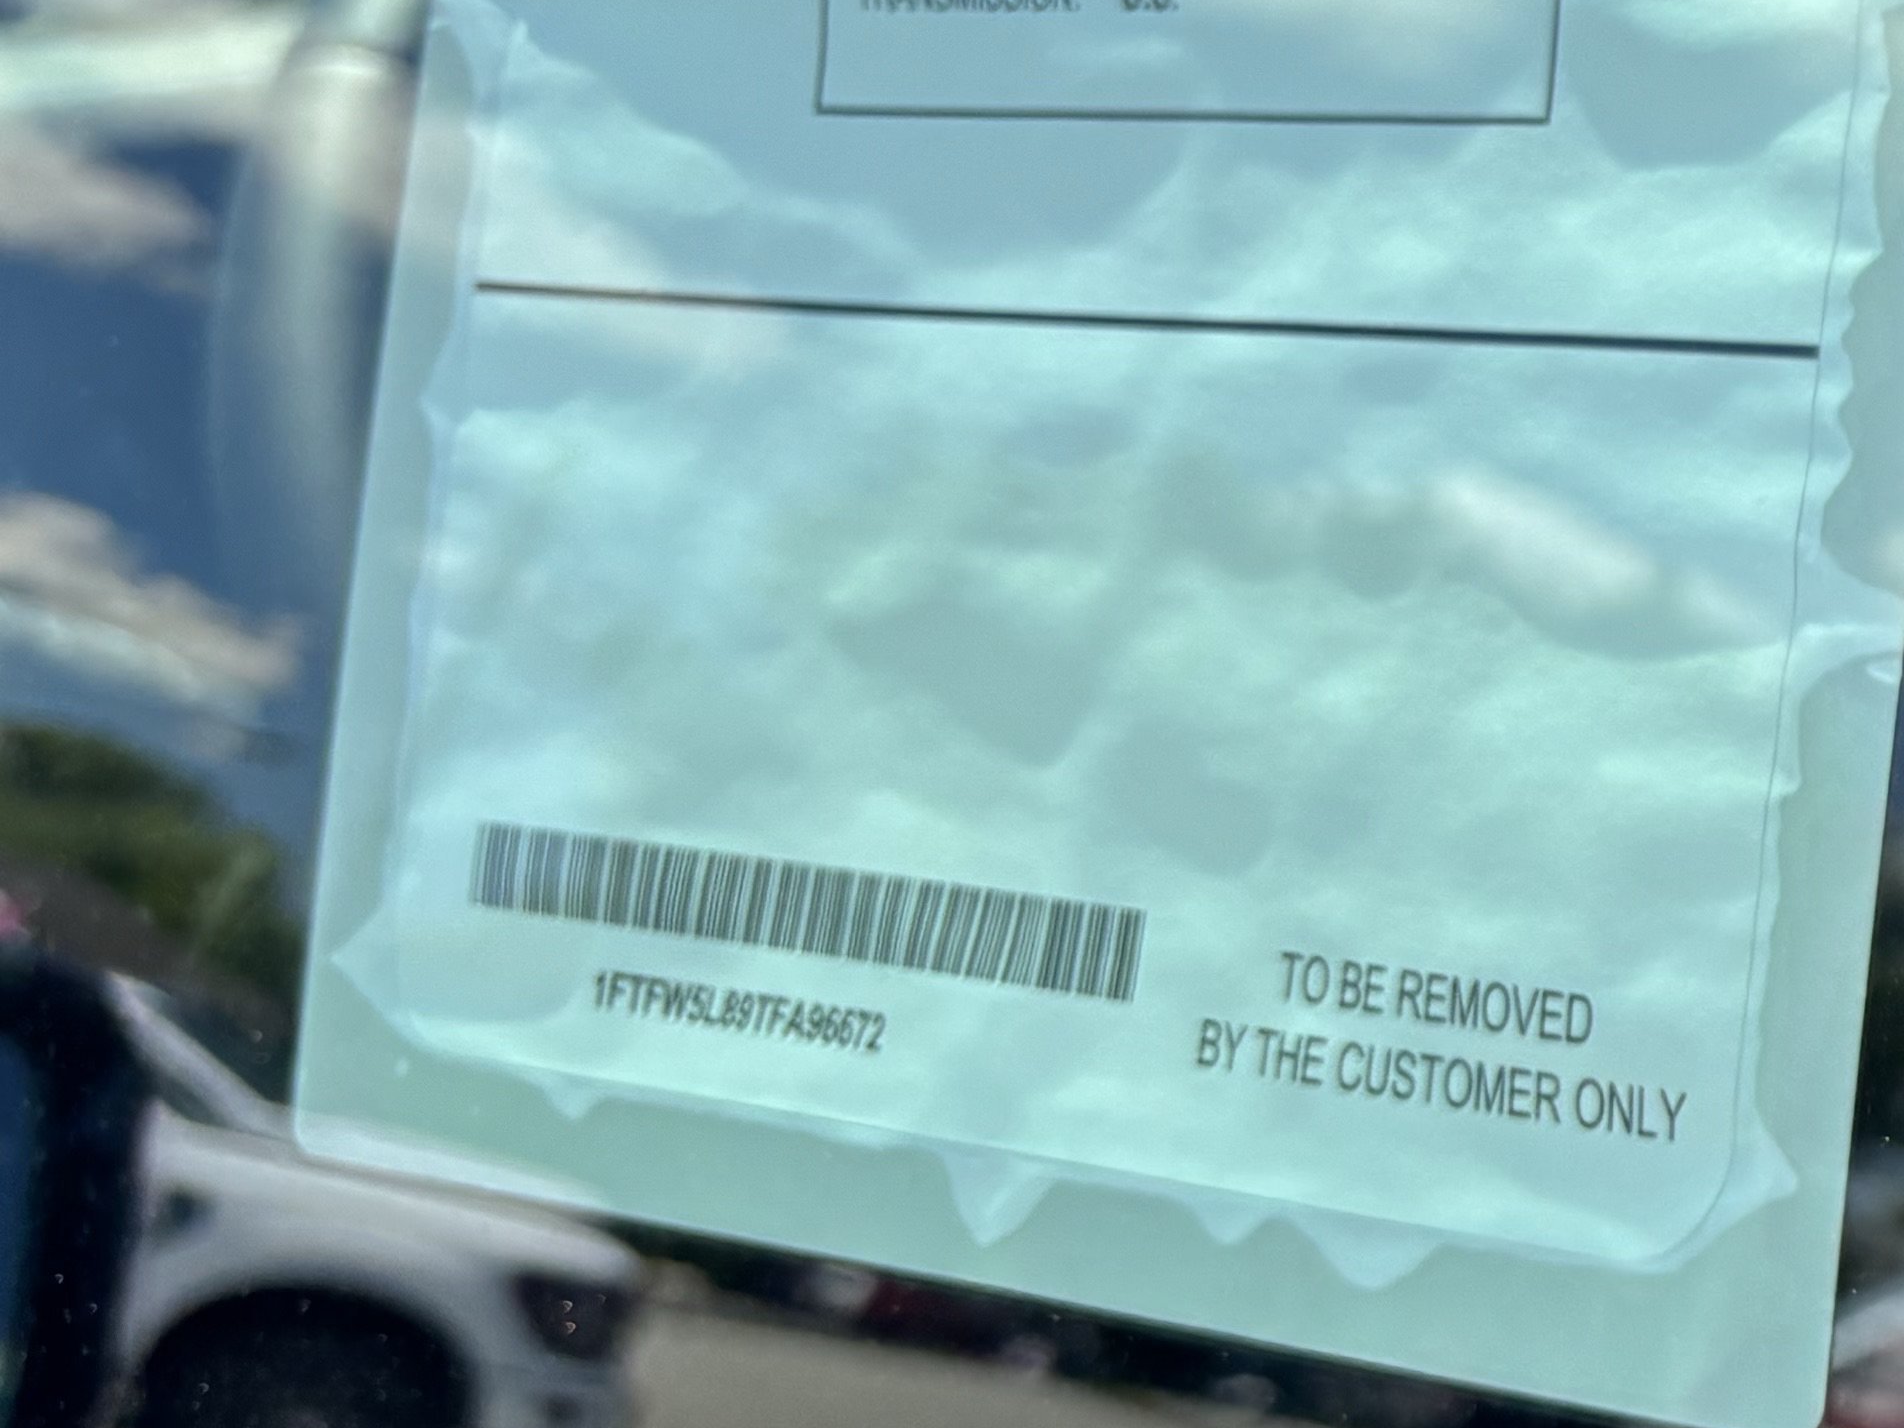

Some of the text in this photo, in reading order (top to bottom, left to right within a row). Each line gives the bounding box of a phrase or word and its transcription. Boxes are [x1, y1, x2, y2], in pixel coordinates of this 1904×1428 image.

[595, 971, 886, 1053] 1FTFW5L89TFA96672
[1281, 950, 1594, 1044] TO BE REMOVED
[1197, 1018, 1688, 1142] BY THE CUSTOMER ONLY
